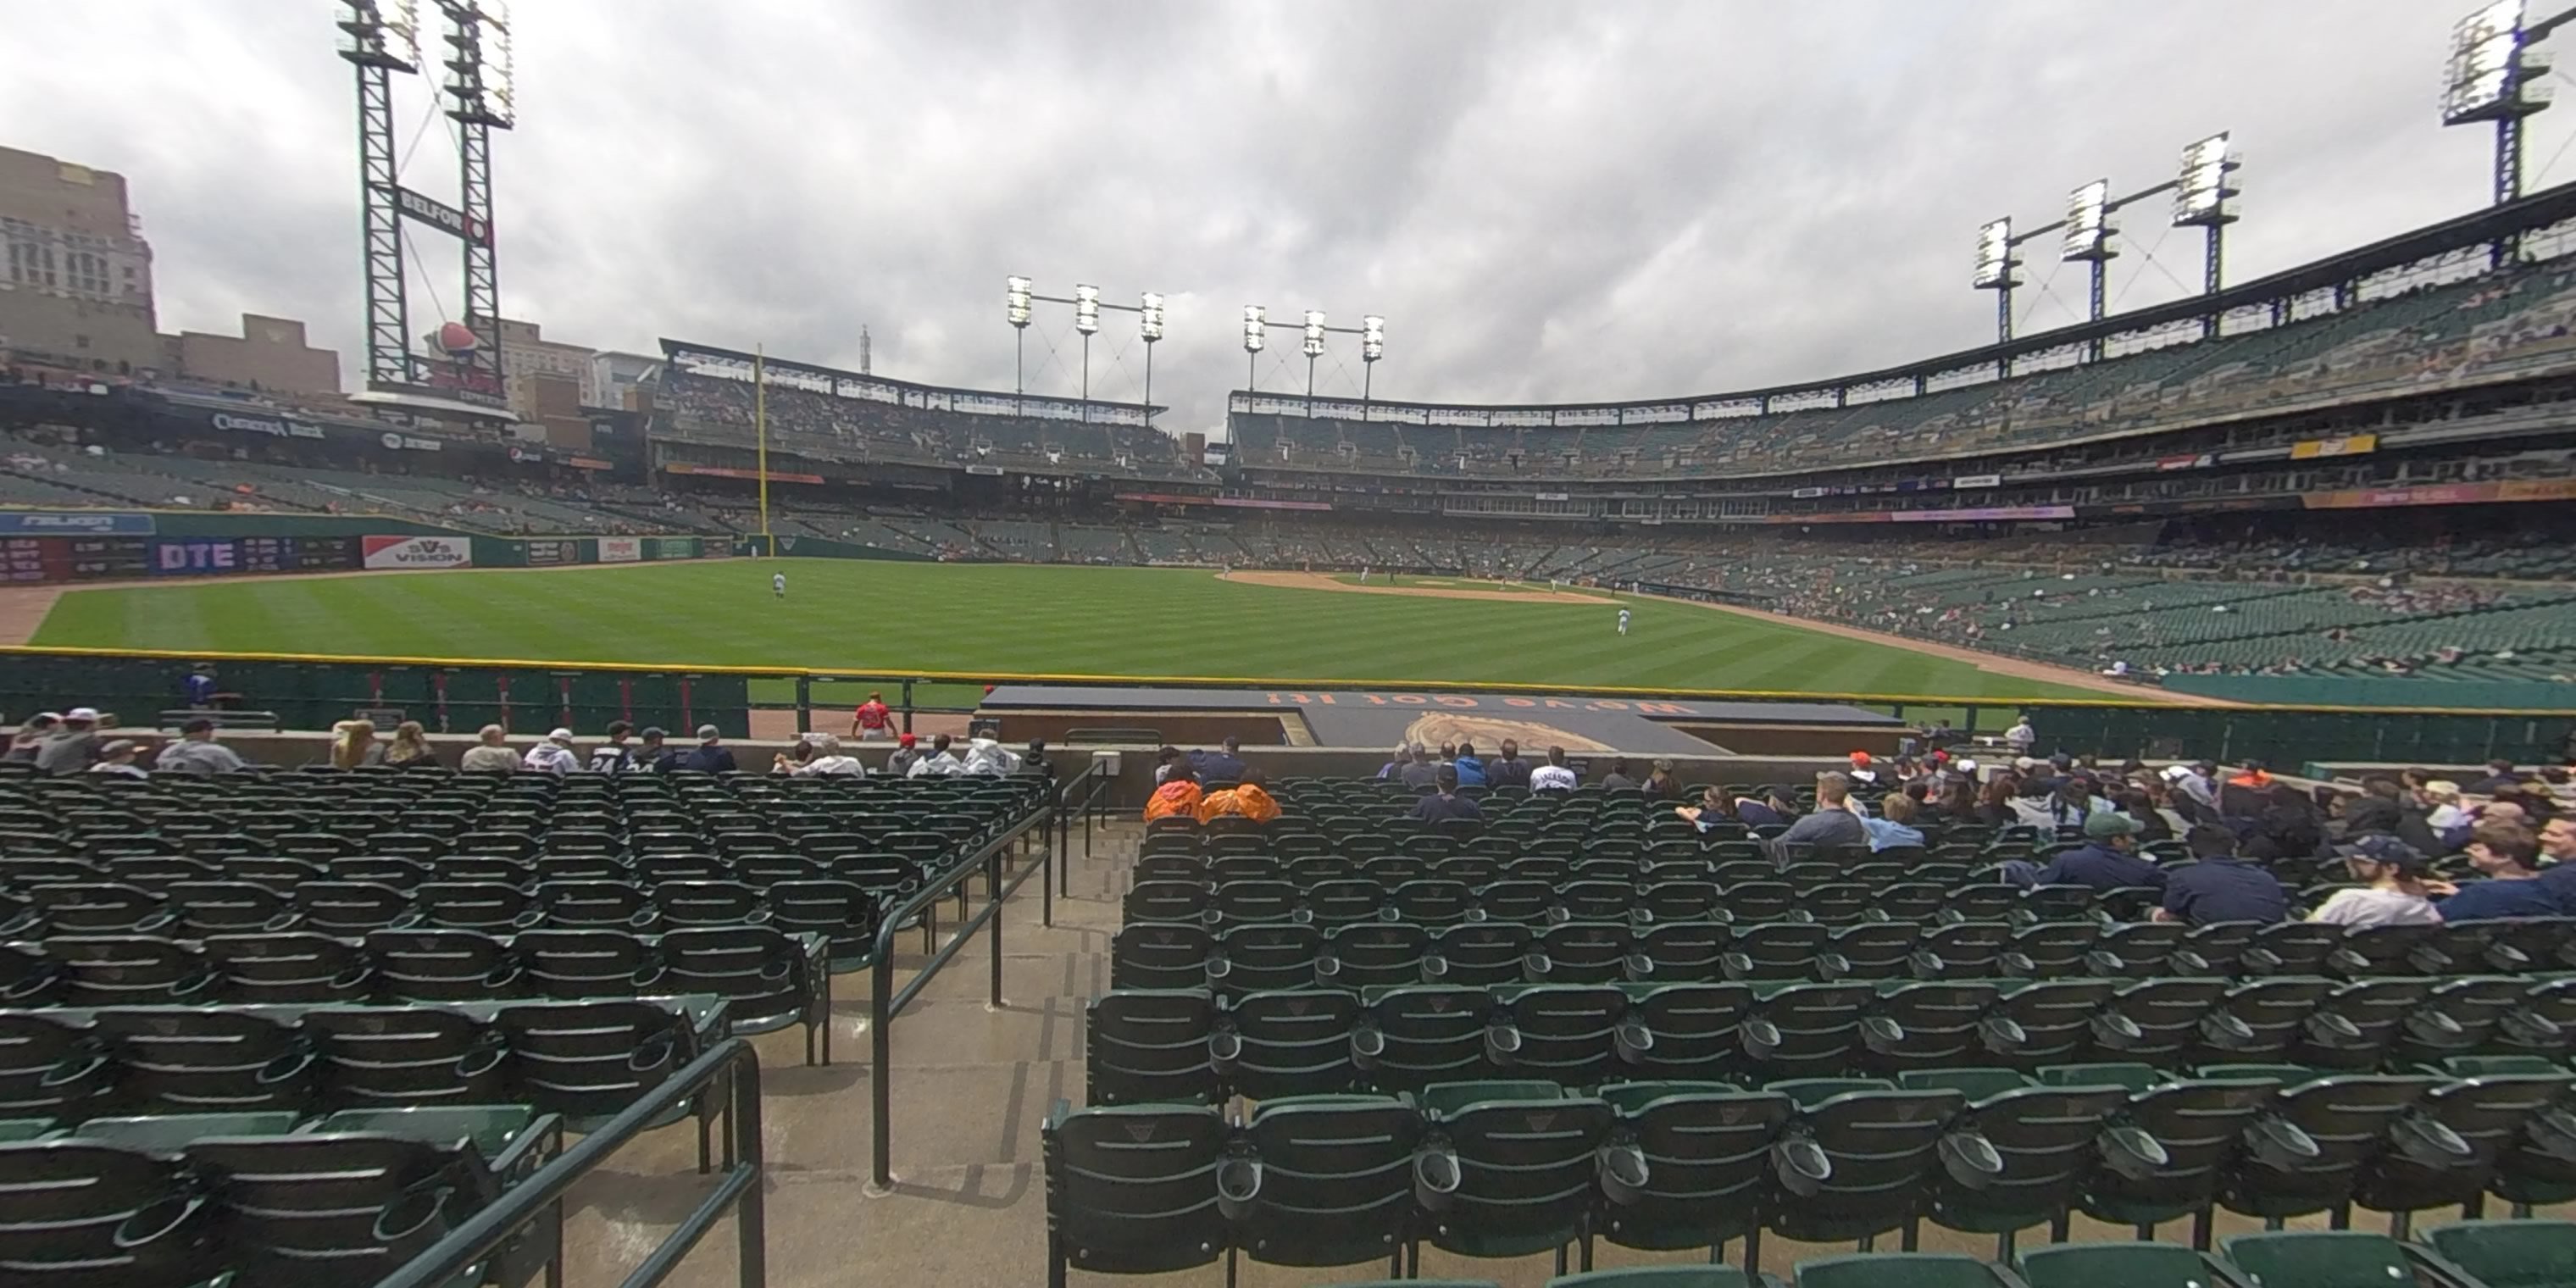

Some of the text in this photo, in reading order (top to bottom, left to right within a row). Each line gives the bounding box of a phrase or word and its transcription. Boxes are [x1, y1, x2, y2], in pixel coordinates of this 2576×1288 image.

[400, 190, 462, 230] BELFOR
[159, 543, 236, 569] DTE
[395, 553, 463, 563] VISION
[1365, 693, 1479, 708] Got
[1503, 697, 1699, 714] We've
